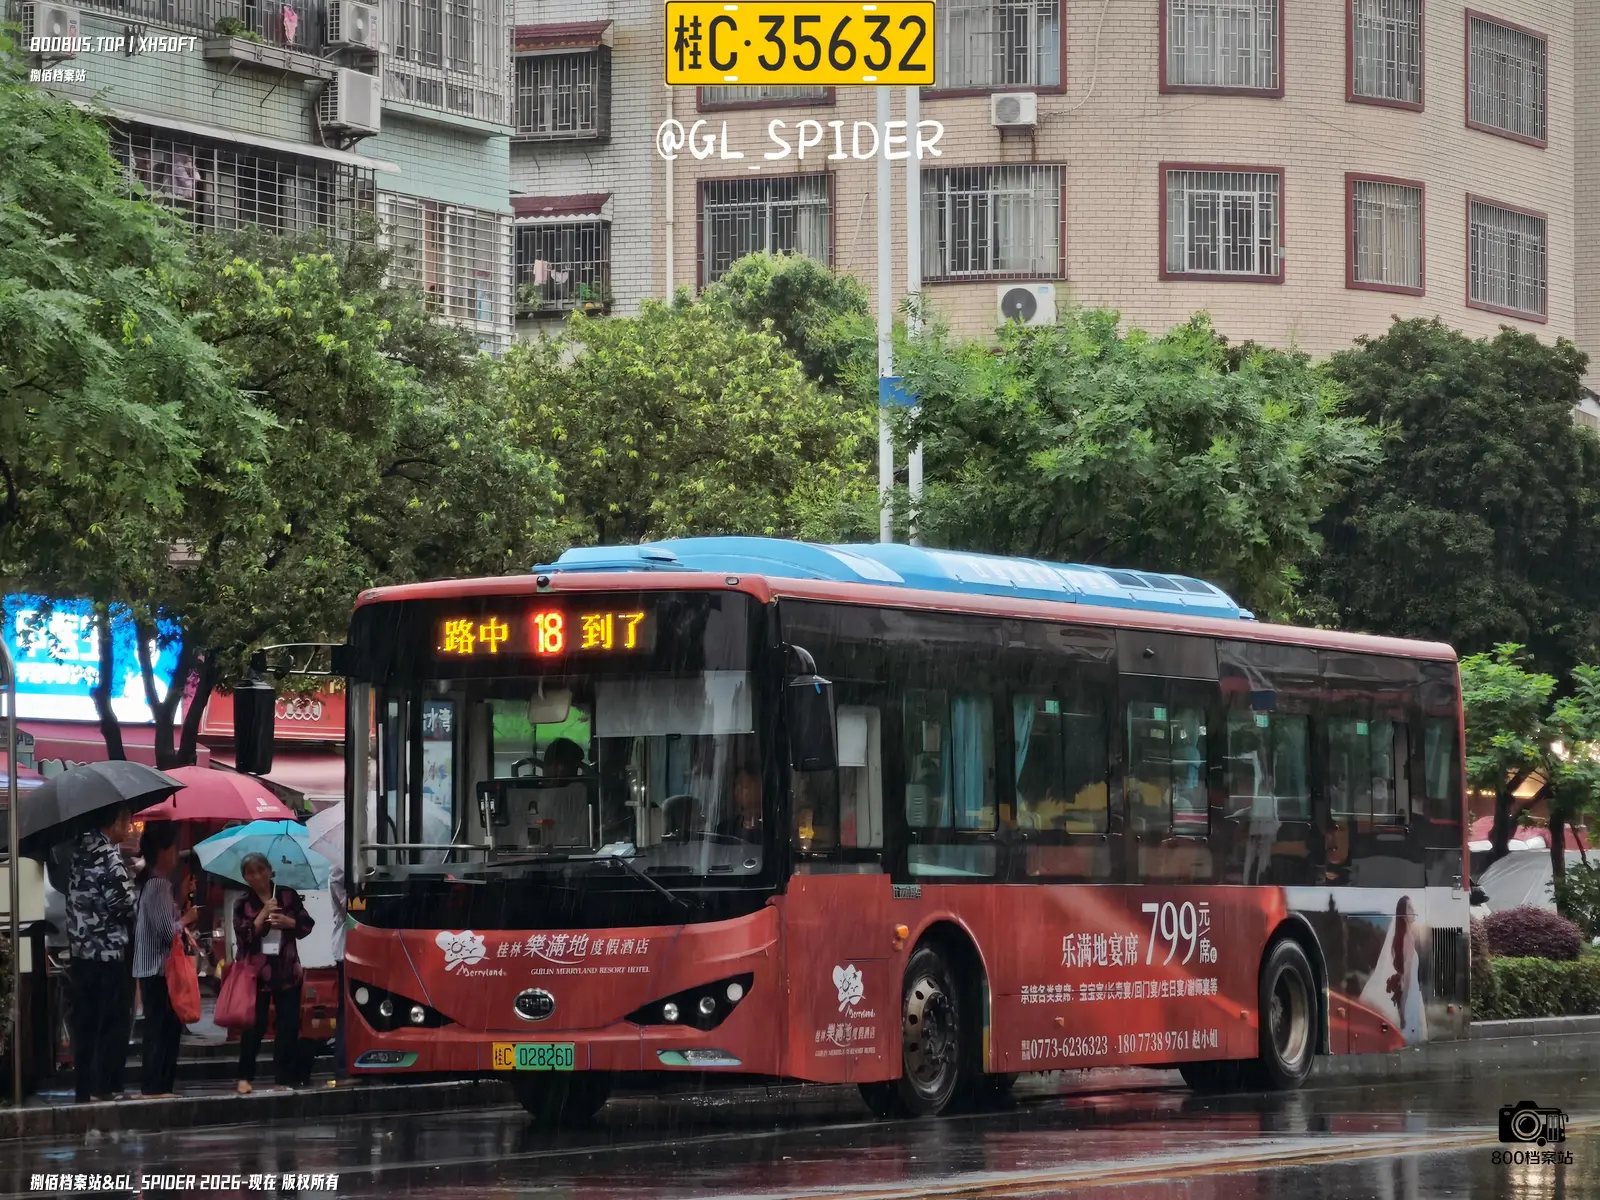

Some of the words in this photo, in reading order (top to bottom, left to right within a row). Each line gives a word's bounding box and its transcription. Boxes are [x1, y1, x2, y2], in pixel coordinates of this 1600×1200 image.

[443, 617, 509, 654] 路中
[534, 612, 563, 653] 18
[581, 612, 645, 649] 到了
[1061, 932, 1139, 967] 乐满地宴席
[1141, 901, 1197, 966] 799
[456, 964, 503, 977] Merryland
[555, 967, 597, 975] MERRYLAND
[1030, 1036, 1108, 1059] 0773-6236323
[1192, 1028, 1218, 1050] 赵小姐
